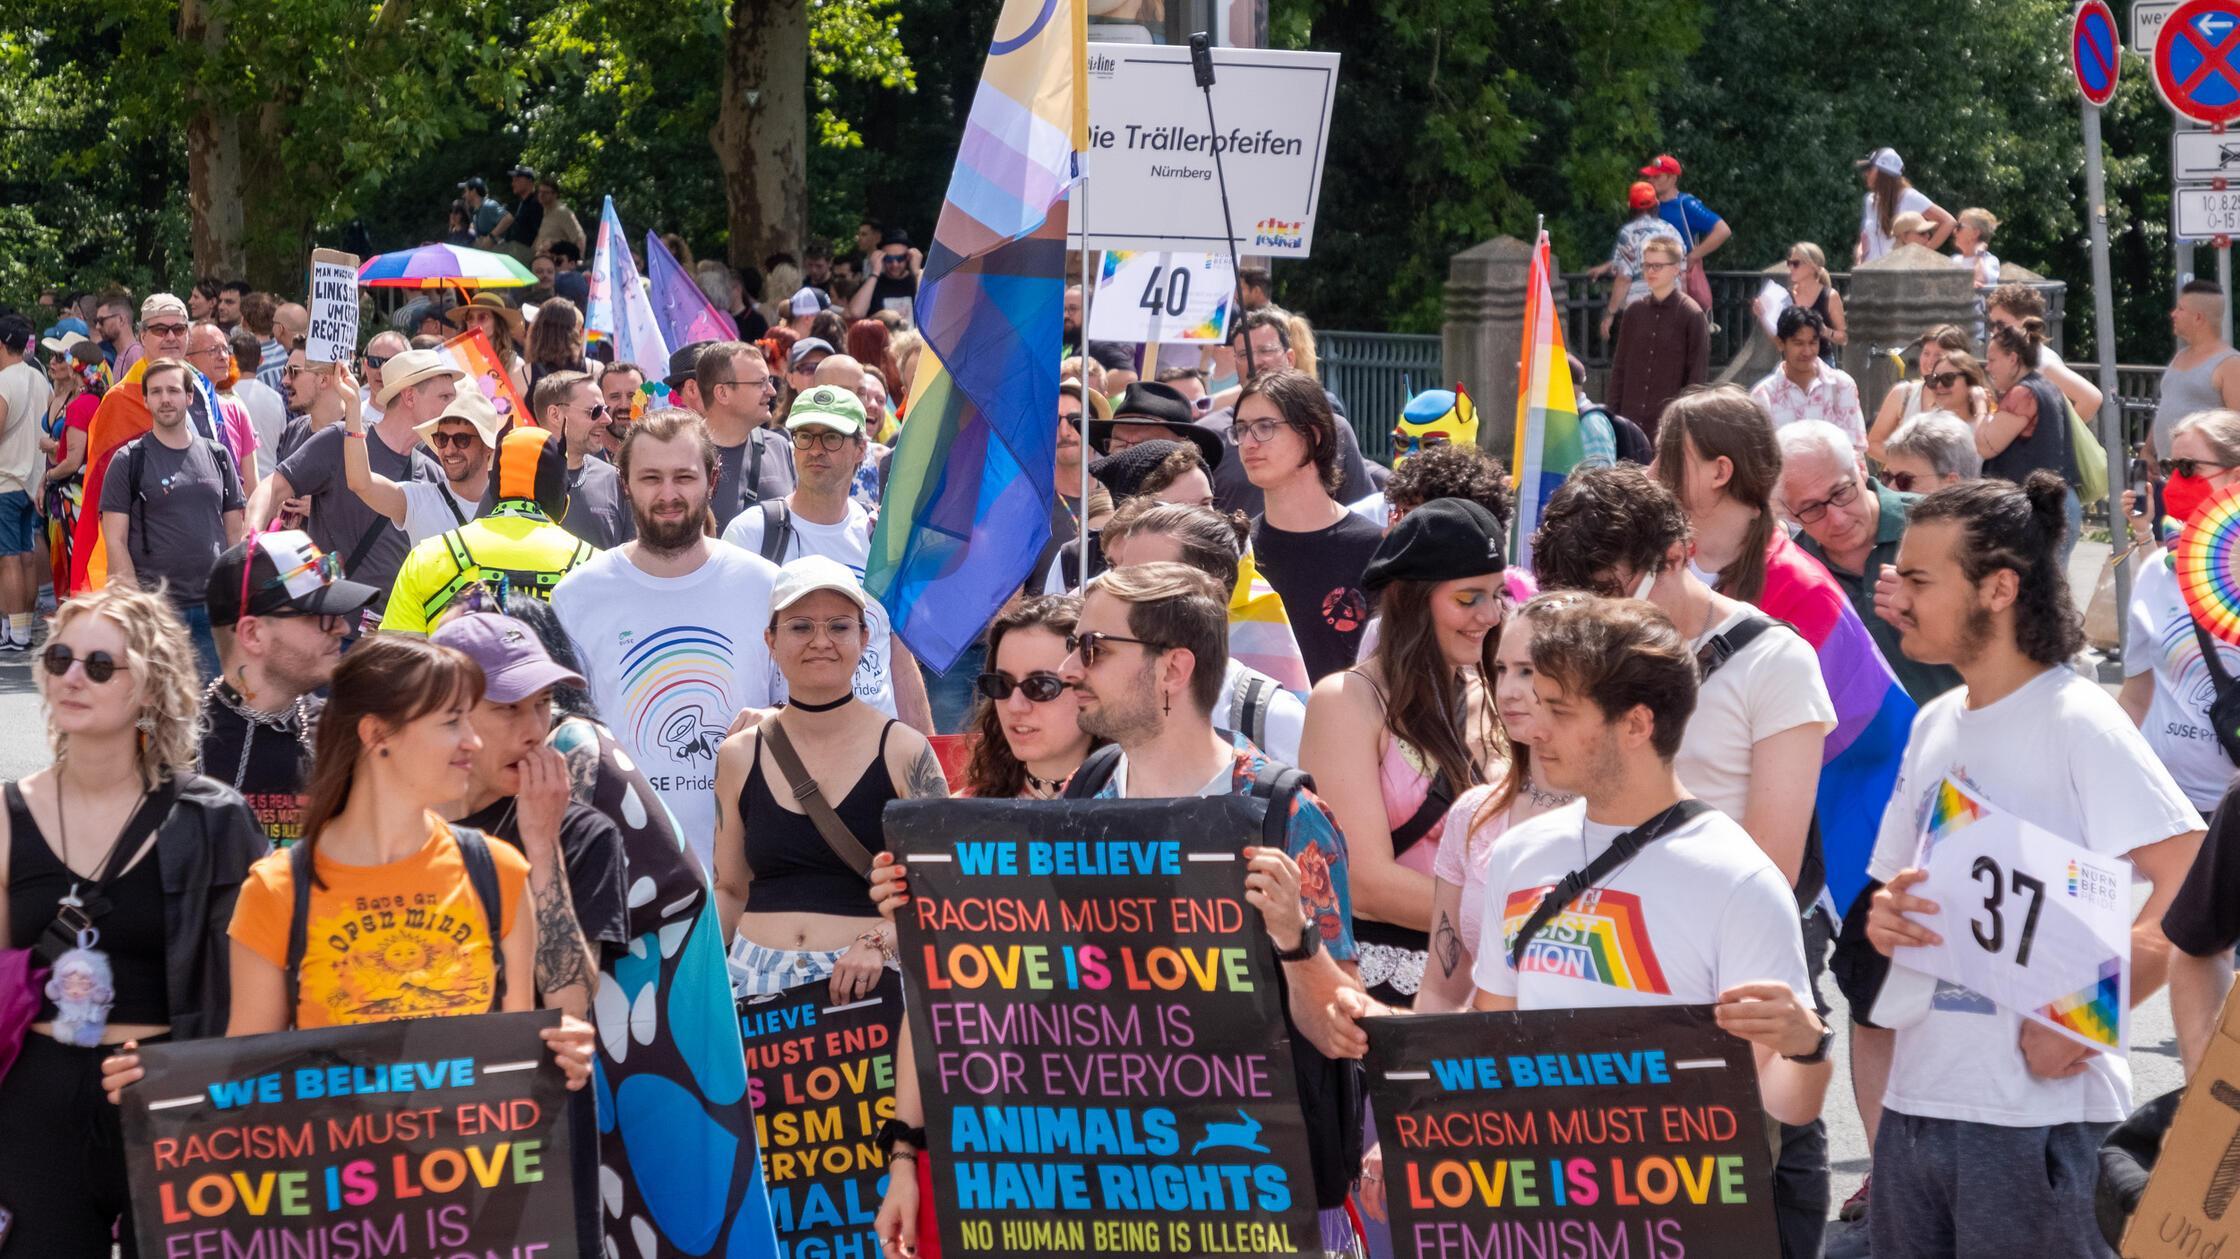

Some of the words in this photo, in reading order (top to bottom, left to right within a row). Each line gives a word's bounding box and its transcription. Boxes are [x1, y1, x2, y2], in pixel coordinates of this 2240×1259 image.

[1088, 125, 1116, 149] ie
[1125, 124, 1303, 157] Trällerpfeifen
[1150, 165, 1212, 181] Nürnberg
[315, 267, 332, 278] MAN
[315, 281, 348, 302] LINKS
[1139, 266, 1191, 317] 40
[854, 682, 880, 696] ride
[2165, 721, 2199, 740] SUSE
[650, 776, 670, 791] SE
[955, 841, 1019, 876] WE
[1028, 841, 1182, 876] BELIEVE
[2081, 879, 2117, 901] BERG
[916, 896, 1050, 932] RACISM
[1059, 897, 1158, 934] MUST
[1170, 898, 1244, 934] END
[1971, 855, 2046, 968] 37
[923, 943, 1054, 990] LOVE
[1061, 944, 1113, 991] IS
[1120, 946, 1255, 992] LOVE
[1523, 944, 1586, 977] TION
[742, 1003, 817, 1038] LIEVE
[825, 1023, 889, 1057] END
[931, 1003, 1143, 1047] FEMINISM
[1156, 1003, 1195, 1048] IS
[208, 1072, 283, 1110] WE
[294, 1057, 476, 1100] BELIEVE
[748, 1077, 767, 1109] S
[783, 1054, 895, 1105] LOVE
[938, 1052, 1028, 1095] FOR
[1041, 1053, 1273, 1097] EVERYONE
[1431, 1057, 1503, 1091] WE
[1507, 1050, 1672, 1088] BELIEVE
[153, 1121, 316, 1172] RACISM
[327, 1106, 443, 1153] MUST
[456, 1098, 542, 1136] END
[858, 1096, 896, 1136] IS
[951, 1105, 1181, 1157] ANIMALS
[1395, 1110, 1539, 1148] RACISM
[1547, 1107, 1649, 1145] MUST
[1661, 1105, 1738, 1143] END
[159, 1171, 312, 1225] LOVE
[324, 1160, 379, 1212] IS
[392, 1140, 544, 1199] LOVE
[954, 1161, 1092, 1210] HAVE
[1097, 1163, 1293, 1212] RIGHTS
[1406, 1159, 1540, 1209] LOVE
[1550, 1157, 1600, 1207] IS
[1610, 1155, 1748, 1205] LOVE
[426, 1204, 470, 1250] IS
[960, 1220, 994, 1251] NO
[1001, 1220, 1085, 1252] HUMAN
[1093, 1221, 1160, 1252] BEING
[1169, 1221, 1192, 1253] IS
[1200, 1222, 1298, 1254] ILLEGAL
[1414, 1220, 1630, 1259] FEMINISM
[1645, 1218, 1686, 1259] IS
